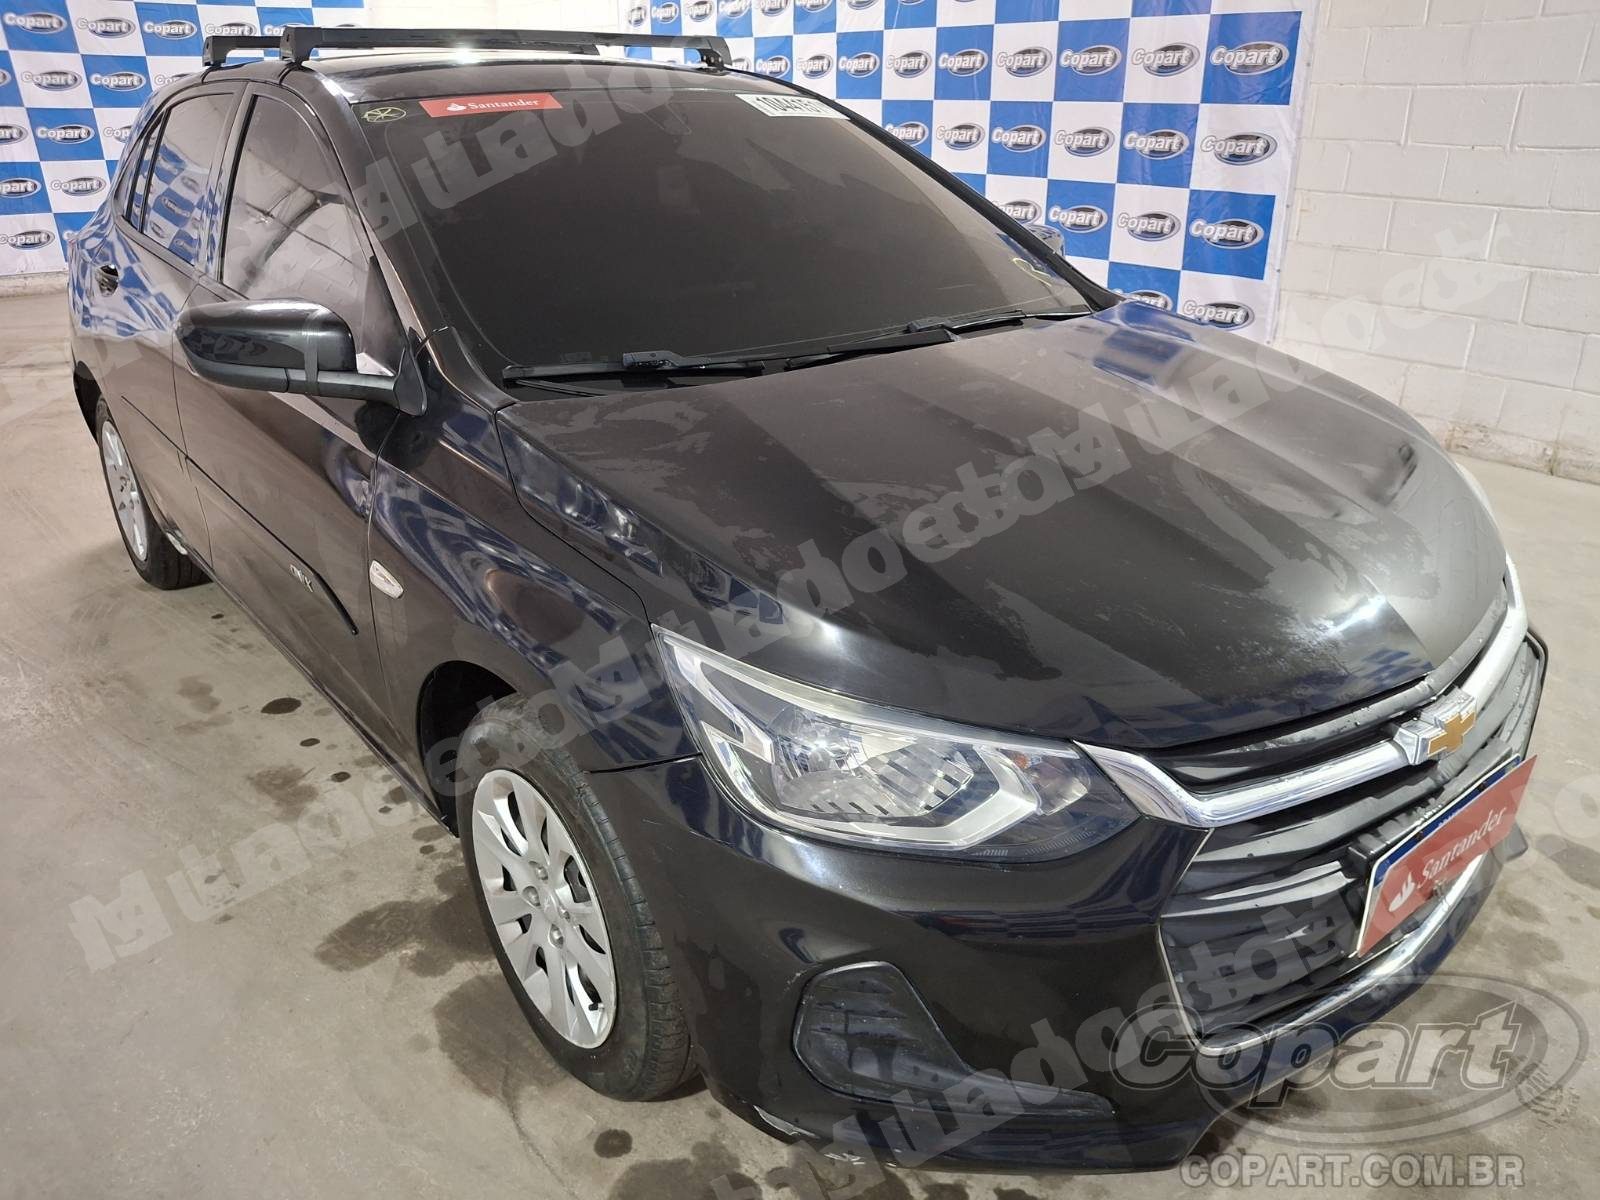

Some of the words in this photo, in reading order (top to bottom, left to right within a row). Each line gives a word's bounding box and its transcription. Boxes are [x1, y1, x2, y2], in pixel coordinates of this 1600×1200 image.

[3, 12, 61, 31] Copart
[77, 17, 130, 34] Copart
[143, 21, 192, 36] Copart
[205, 23, 252, 36] Copart
[755, 59, 787, 75] Copart
[838, 56, 876, 73] Copart
[886, 54, 926, 71] Copart
[938, 53, 983, 72] Copart
[996, 48, 1045, 70] Copart
[1059, 46, 1116, 70] Copart
[1131, 46, 1190, 71] Copart
[1210, 45, 1278, 71] Copart
[22, 72, 75, 90] Copart
[90, 73, 140, 88] Copart
[467, 99, 540, 109] Santander
[37, 126, 89, 142] Copart
[936, 126, 978, 144] Copart
[992, 127, 1040, 147] Copart
[1055, 130, 1106, 151] Copart
[1124, 132, 1180, 156] Copart
[1201, 135, 1267, 160] Copart
[51, 179, 100, 195] Copart
[1050, 207, 1100, 230] Copart
[1117, 212, 1172, 237] Copart
[1189, 219, 1254, 246] Copart
[1183, 300, 1246, 325] Copart
[1417, 806, 1507, 889] Santander
